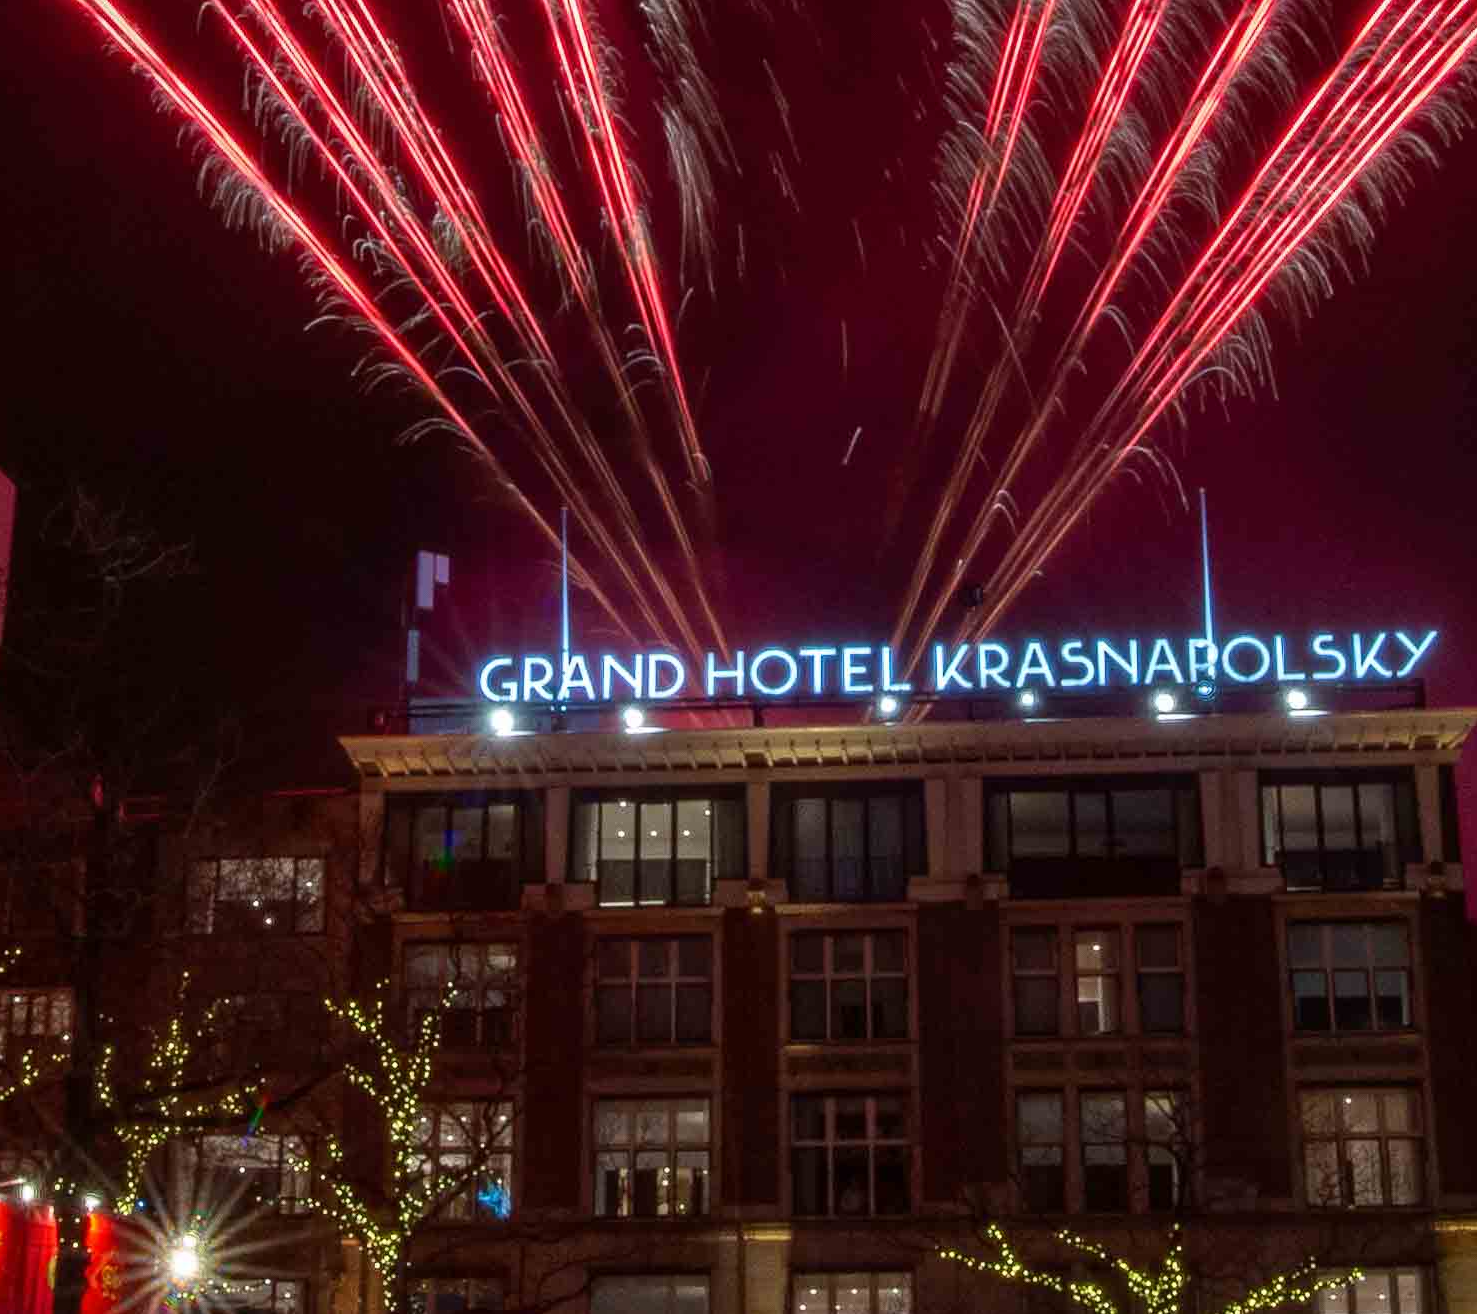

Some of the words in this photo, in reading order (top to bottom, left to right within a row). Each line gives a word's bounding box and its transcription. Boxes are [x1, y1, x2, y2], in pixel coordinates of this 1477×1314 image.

[479, 652, 686, 702] GRAND
[706, 645, 912, 697] HOTEL
[934, 630, 1438, 692] KRASNAPOLSKY
